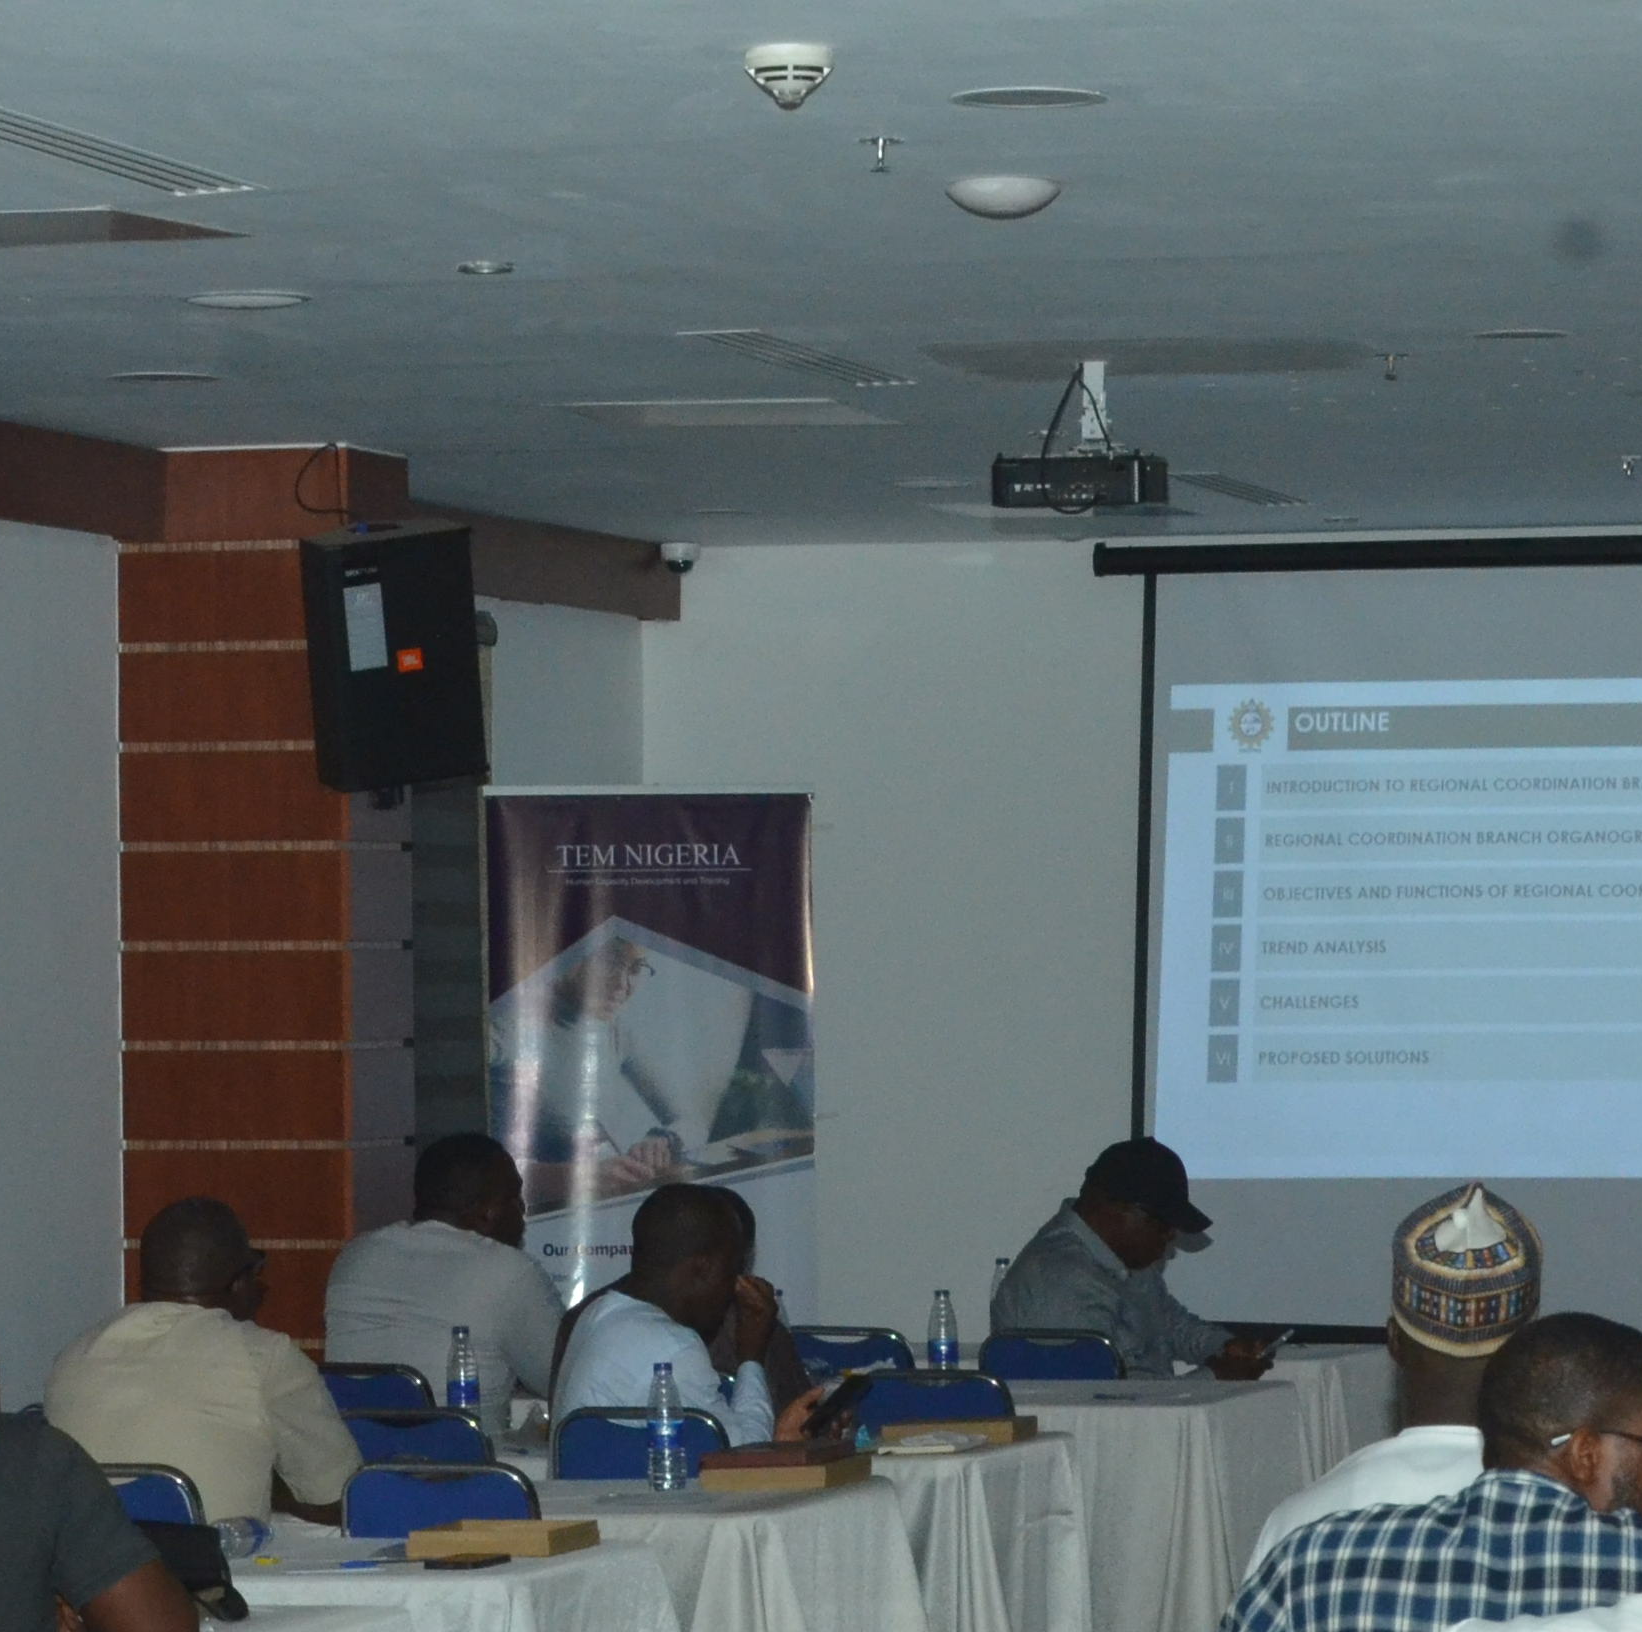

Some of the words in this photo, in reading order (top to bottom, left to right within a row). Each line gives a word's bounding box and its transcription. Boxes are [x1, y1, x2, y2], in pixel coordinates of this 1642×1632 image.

[1294, 711, 1390, 733] OUTLINE
[1265, 777, 1380, 795] INTRODUCTION
[1385, 778, 1405, 792] TO
[1409, 778, 1488, 793] REGIONAL
[1493, 776, 1617, 792] COORDINATION
[1265, 832, 1343, 848] REGIONAL
[1347, 831, 1471, 846] COORDINATION
[1476, 831, 1542, 846] BRANCH
[557, 844, 616, 867] TEM
[624, 842, 742, 866] NIGERIA
[1263, 885, 1352, 902] OBJECTIVES
[1357, 886, 1392, 900] AND
[1396, 884, 1483, 900] FUNCTIONS
[1487, 884, 1508, 899] OF
[1513, 884, 1593, 899] REGIONAL
[1261, 941, 1308, 955] TREND
[1312, 939, 1387, 954] ANALYSIS
[1260, 995, 1360, 1010] CHALLENGES
[1258, 1051, 1340, 1066] PROPOSED
[1345, 1050, 1430, 1066] SOLUTIONS
[543, 1244, 570, 1257] Our
